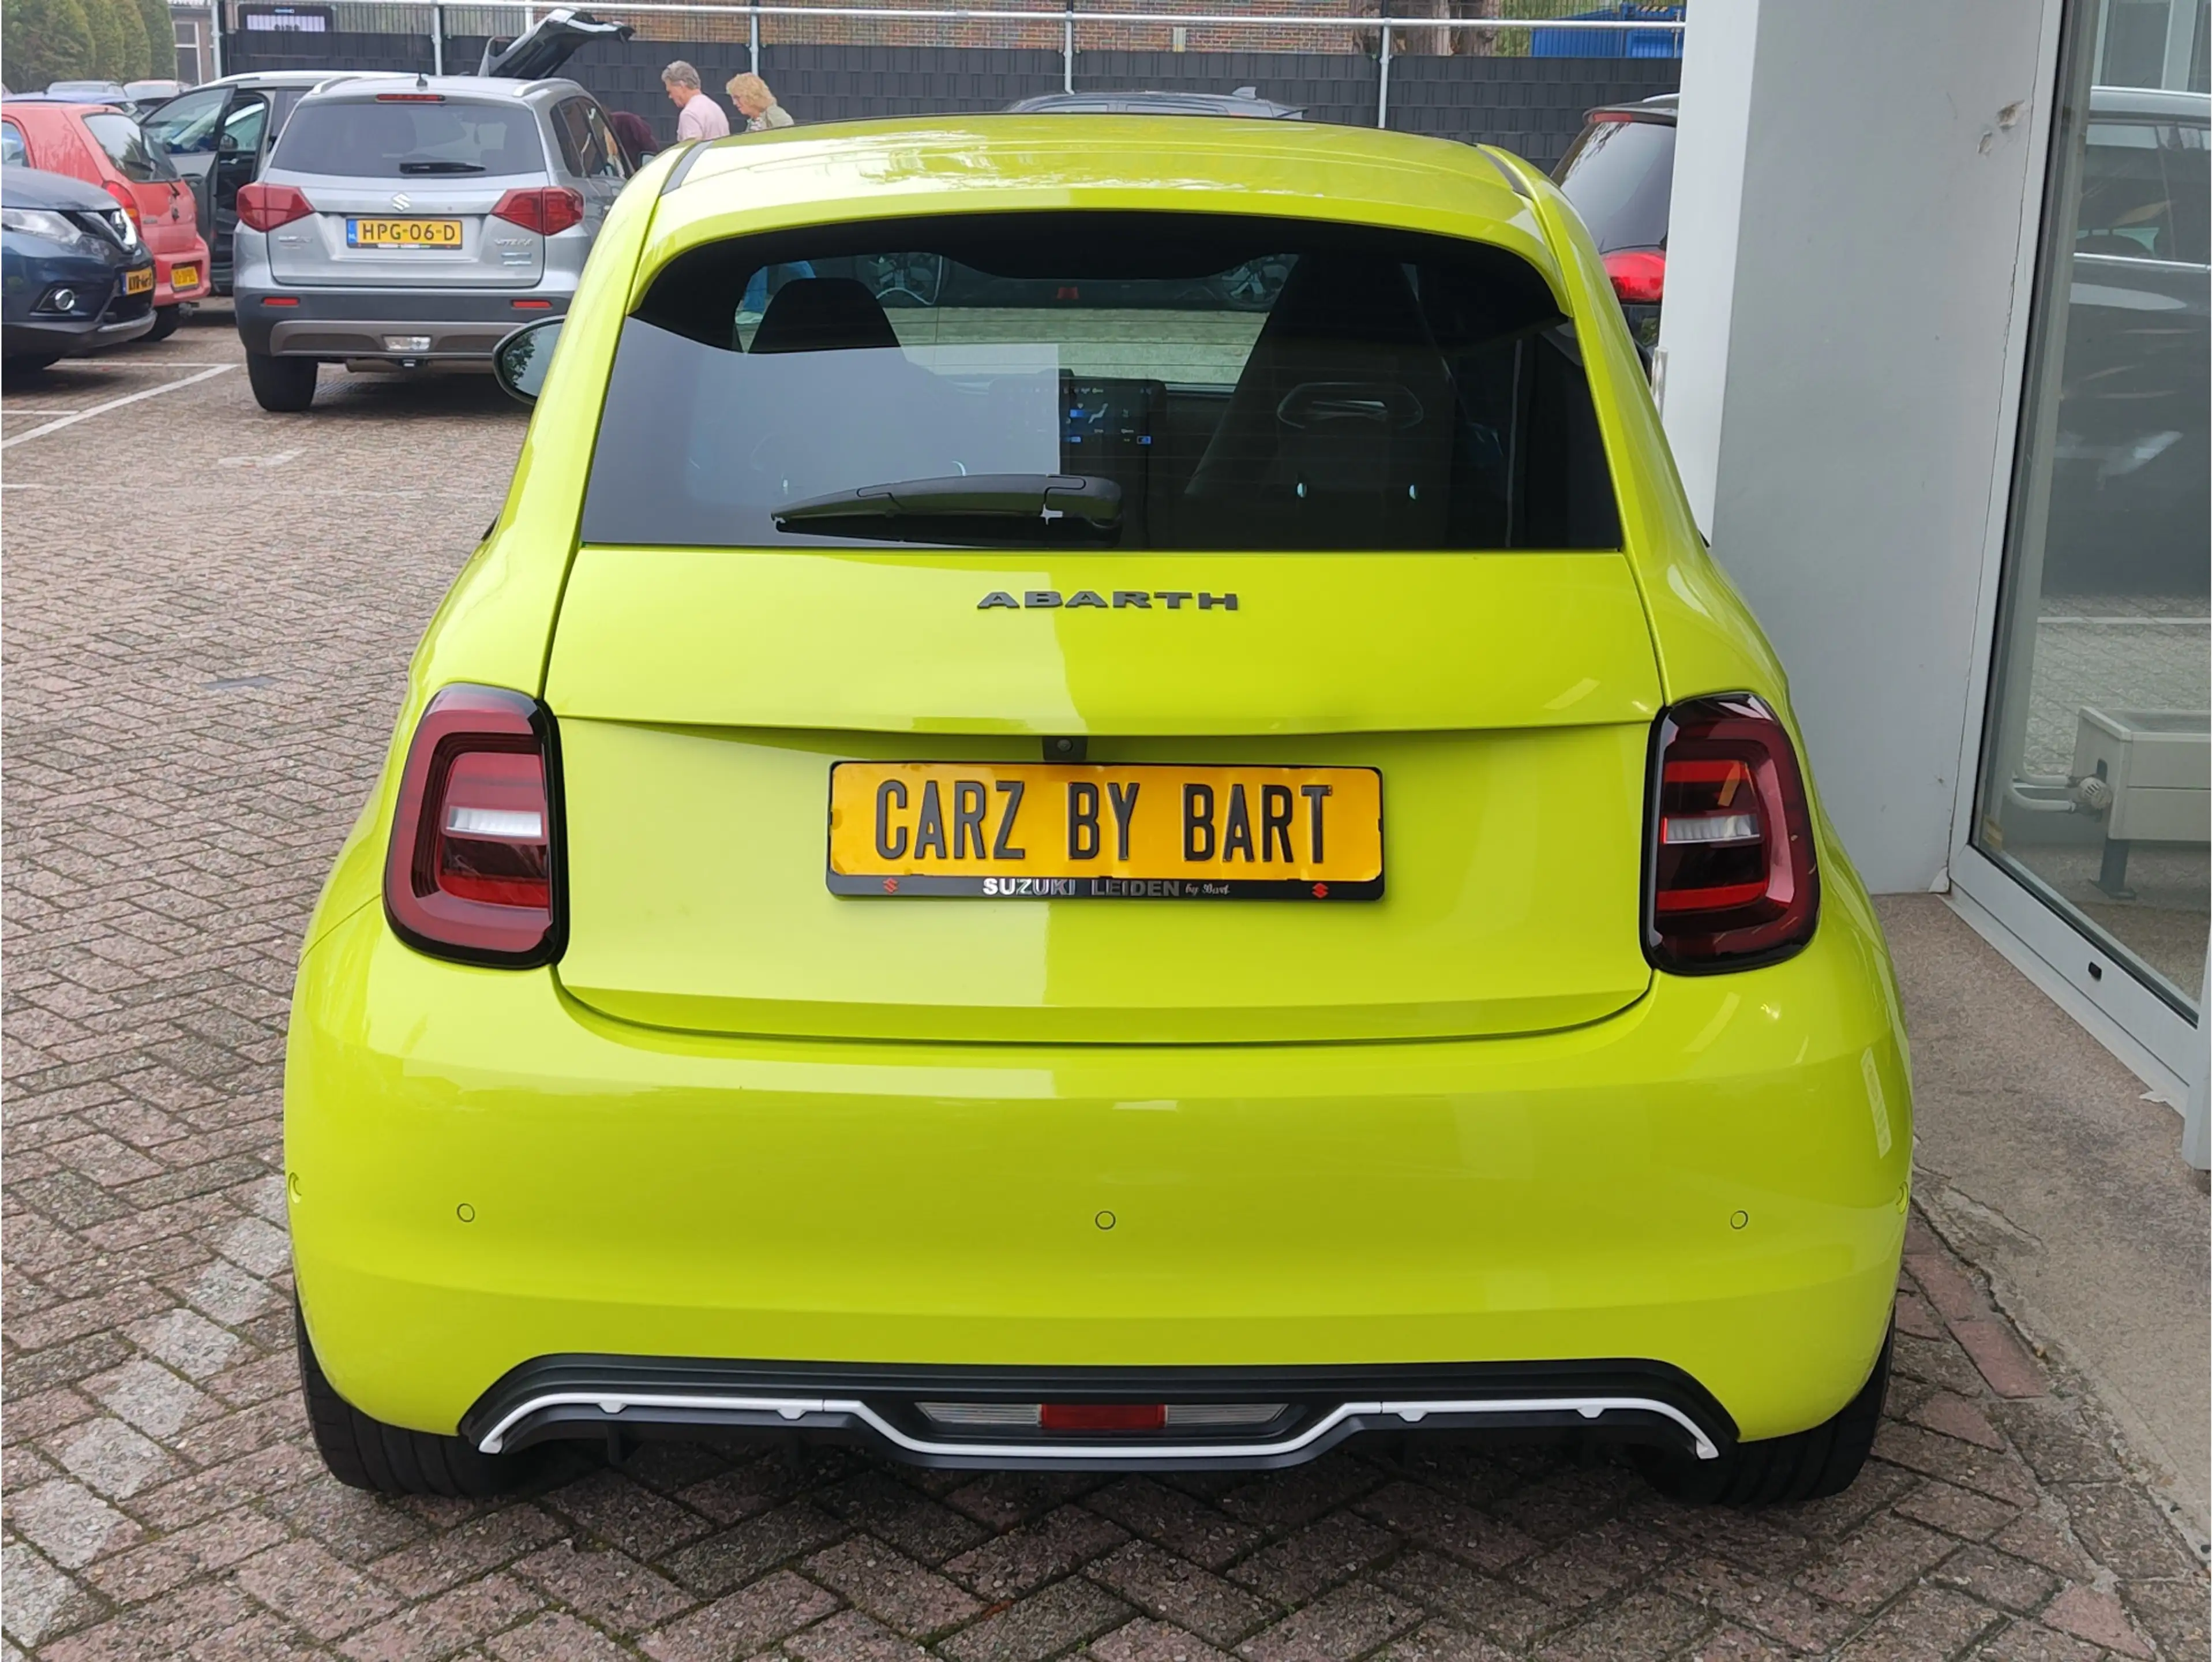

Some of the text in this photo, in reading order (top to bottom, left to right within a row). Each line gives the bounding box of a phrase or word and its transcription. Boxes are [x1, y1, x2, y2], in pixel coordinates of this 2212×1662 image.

[363, 223, 455, 241] HPG-06-D
[977, 591, 1239, 611] ABARTH
[875, 779, 1333, 864] CARZ BY BART
[982, 877, 1231, 897] SUZUKI LEIDEN by Bart
